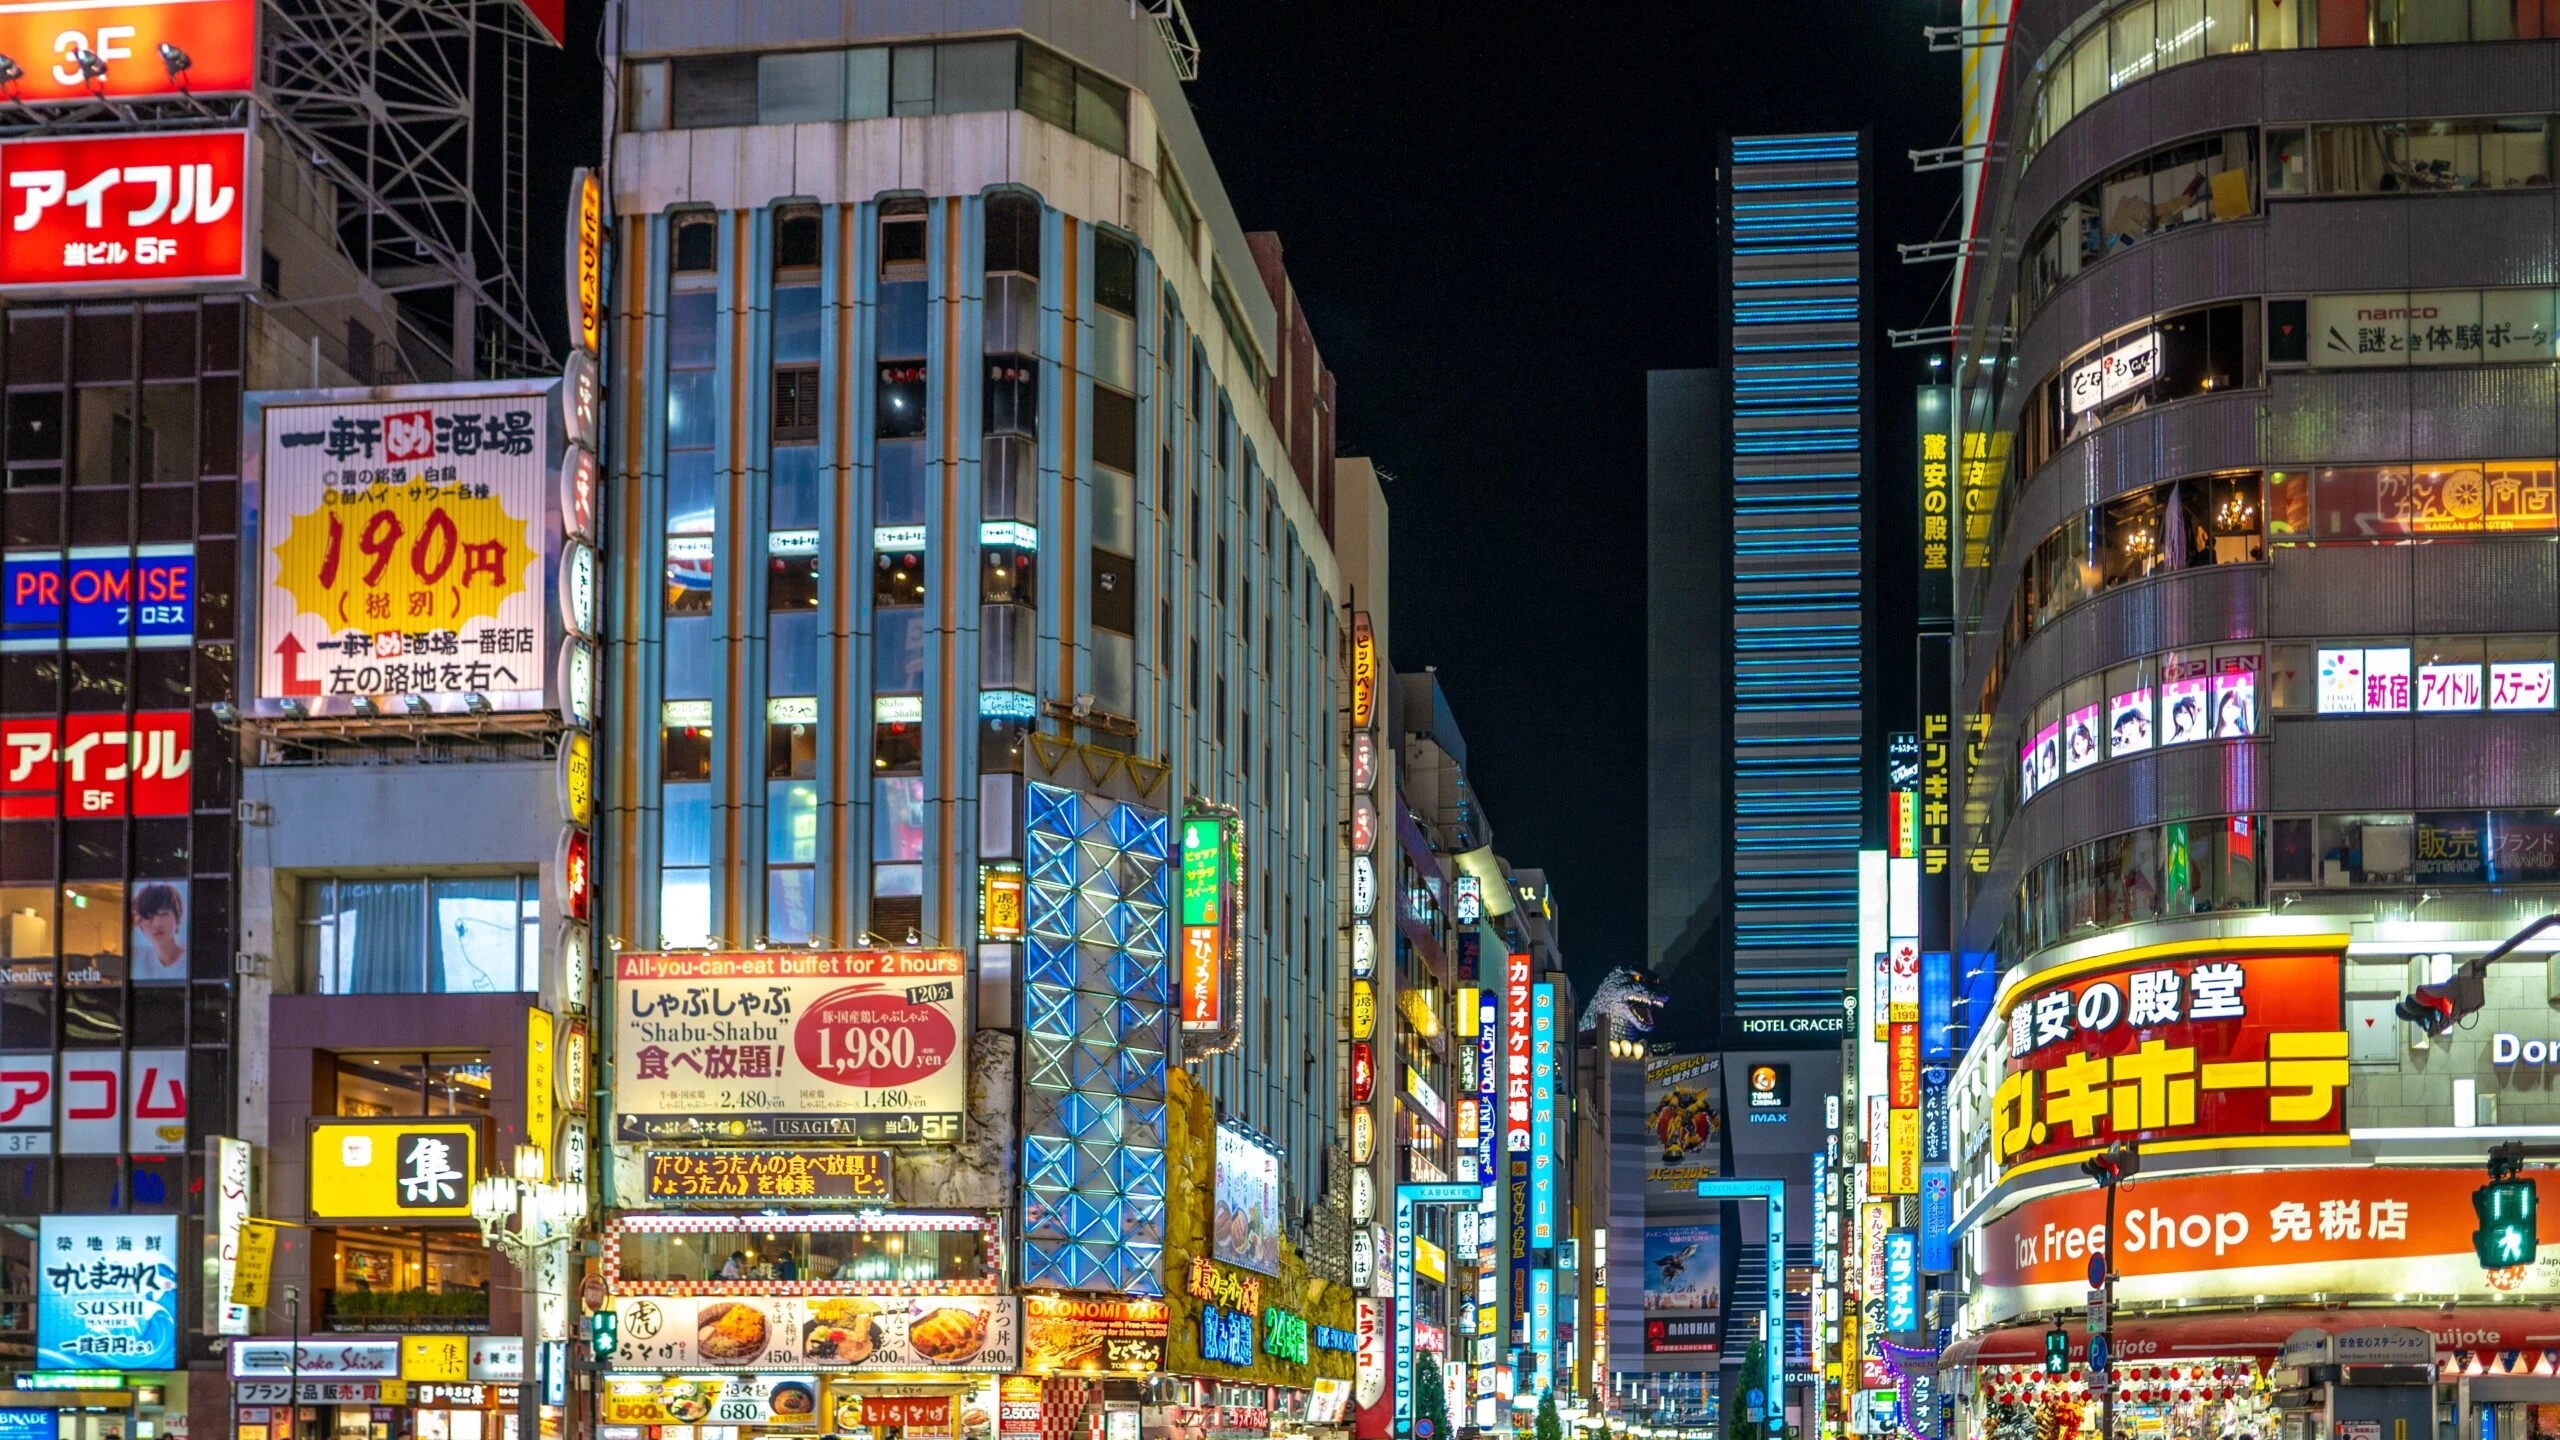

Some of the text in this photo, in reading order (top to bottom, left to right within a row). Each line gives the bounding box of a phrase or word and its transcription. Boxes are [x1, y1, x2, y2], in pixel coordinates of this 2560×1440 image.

[52, 26, 136, 85] 3F
[9, 163, 235, 231] アイフル
[63, 237, 178, 266] 当ビル 5F
[2357, 307, 2438, 321] namco
[280, 410, 535, 463] 一軒め酒場
[1924, 433, 1947, 570] 驚安の殿堂
[318, 506, 508, 590] 190円
[15, 567, 188, 606] PROMISE
[328, 661, 518, 695] 左の路地を右へ
[1357, 635, 1369, 715] ピックペック
[2368, 670, 2552, 709] 新宿 アイドル ステージ
[6, 730, 192, 782] アイフル
[83, 790, 114, 810] 5F
[2418, 828, 2478, 859] 販売
[2494, 832, 2554, 853] ブランド
[0, 968, 54, 983] Neolive
[625, 954, 958, 977] All-you-can-eat buffet for 2 hours
[1190, 939, 1212, 1018] ひょうたん
[631, 986, 791, 1018] しゃぶしゃぶ
[908, 985, 949, 1005] 120分
[822, 1009, 929, 1023] 豚・国産鶏しゃぶしゃぶ
[2010, 962, 2246, 1060] 驚安の殿堂
[1743, 1020, 1787, 1032] HOTEL
[1901, 1025, 1912, 1034] 5F
[816, 1026, 941, 1075] 1,980 yen
[1509, 961, 1529, 1123] カラオケ歌広場
[0, 1068, 186, 1123] アコム
[720, 1089, 766, 1109] 2,480
[765, 1098, 785, 1110] yen
[862, 1089, 908, 1108] 1,480
[908, 1098, 927, 1108] yen
[922, 1115, 958, 1138] 5F
[1751, 1114, 1787, 1123] IMAX
[9, 1136, 37, 1151] 3F
[398, 1137, 463, 1203] 集
[758, 1175, 814, 1195] を検索
[1512, 1181, 1526, 1259] マツモトキヨシ
[57, 1236, 161, 1251] 築地海鮮
[2015, 1199, 2409, 1271] Tax Free Shop 免税店
[1891, 1237, 1912, 1327] カラオケ
[77, 1301, 143, 1315] SUSHI
[1029, 1301, 1169, 1319] OKONOMI YAKI
[1398, 1222, 1410, 1398] GODZILLA ROAD
[1771, 1233, 1783, 1382] ゴジラロード
[996, 1300, 1010, 1345] かつ丼
[1669, 1323, 1715, 1335] MARUHAN
[61, 1337, 128, 1355] 一貫百円
[1360, 1304, 1373, 1367] トラノコ
[2339, 1337, 2424, 1348] 安全安心ステーション
[2435, 1328, 2500, 1348] uijote
[340, 1347, 384, 1371] Shira
[764, 1351, 799, 1363] 450円
[870, 1351, 904, 1363] 500円
[977, 1351, 1012, 1363] 490円
[1864, 1363, 1882, 1378] 2F
[720, 1404, 766, 1420] 680円
[867, 1404, 947, 1422] とらそば
[1916, 1375, 1930, 1433] カラオケ
